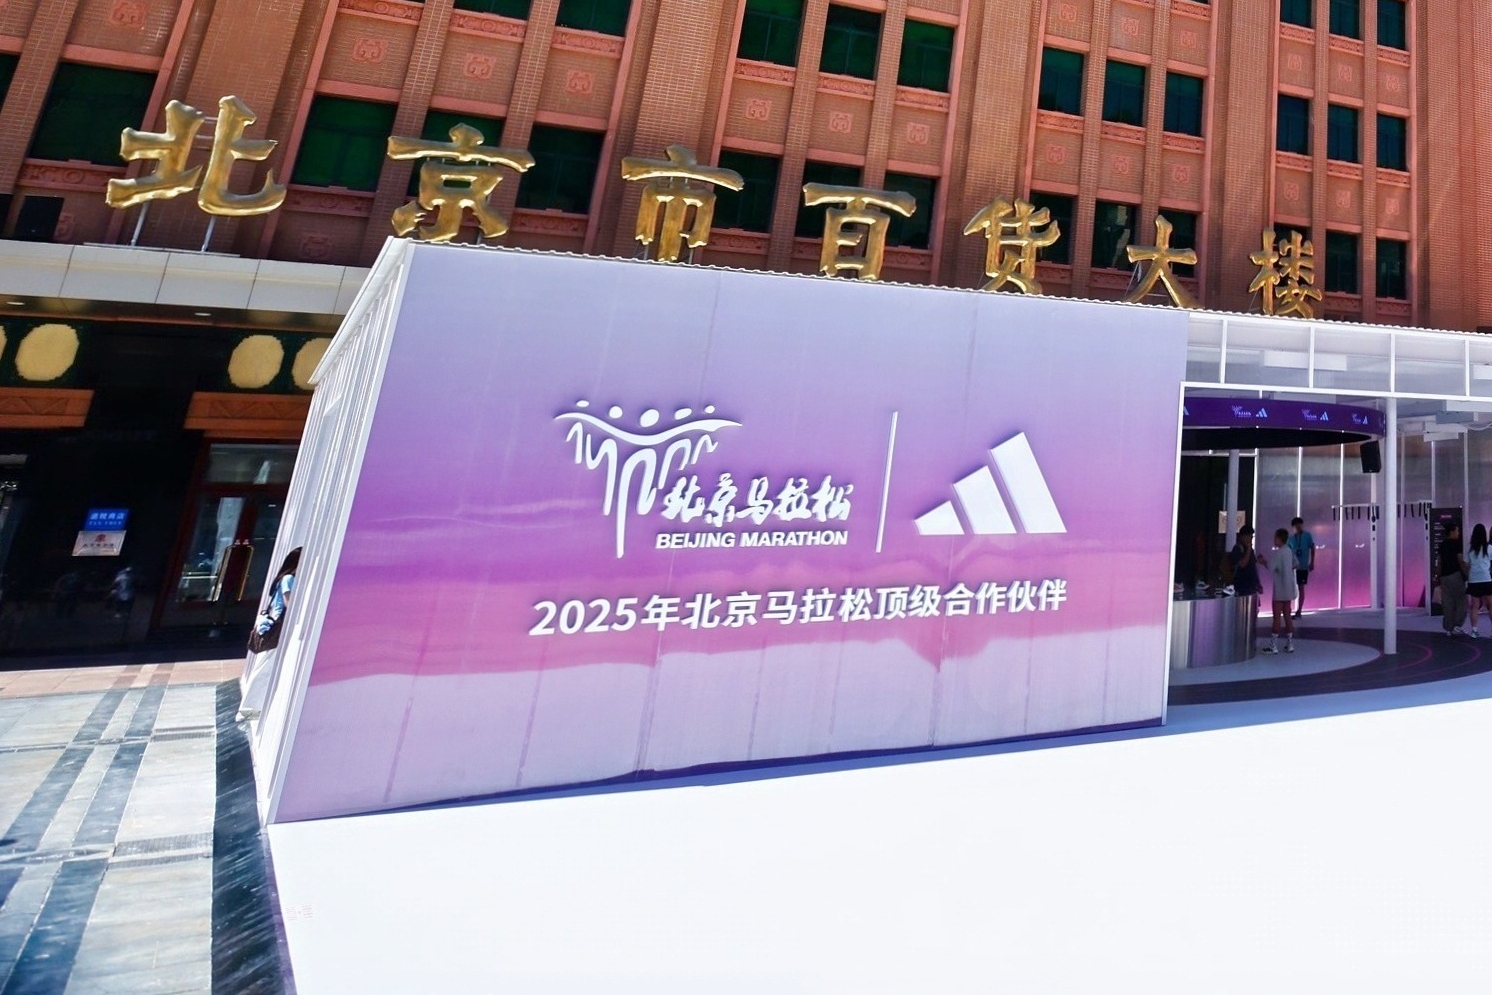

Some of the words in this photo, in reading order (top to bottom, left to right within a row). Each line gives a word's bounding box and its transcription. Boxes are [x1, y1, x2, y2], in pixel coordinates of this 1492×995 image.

[105, 95, 1324, 318] 北京市百货大楼
[660, 472, 855, 528] 北京马拉松
[655, 532, 736, 549] BEIJING
[739, 530, 849, 547] MARATHON
[529, 578, 1068, 636] 2025年北京马拉松顶级合作伙伴
